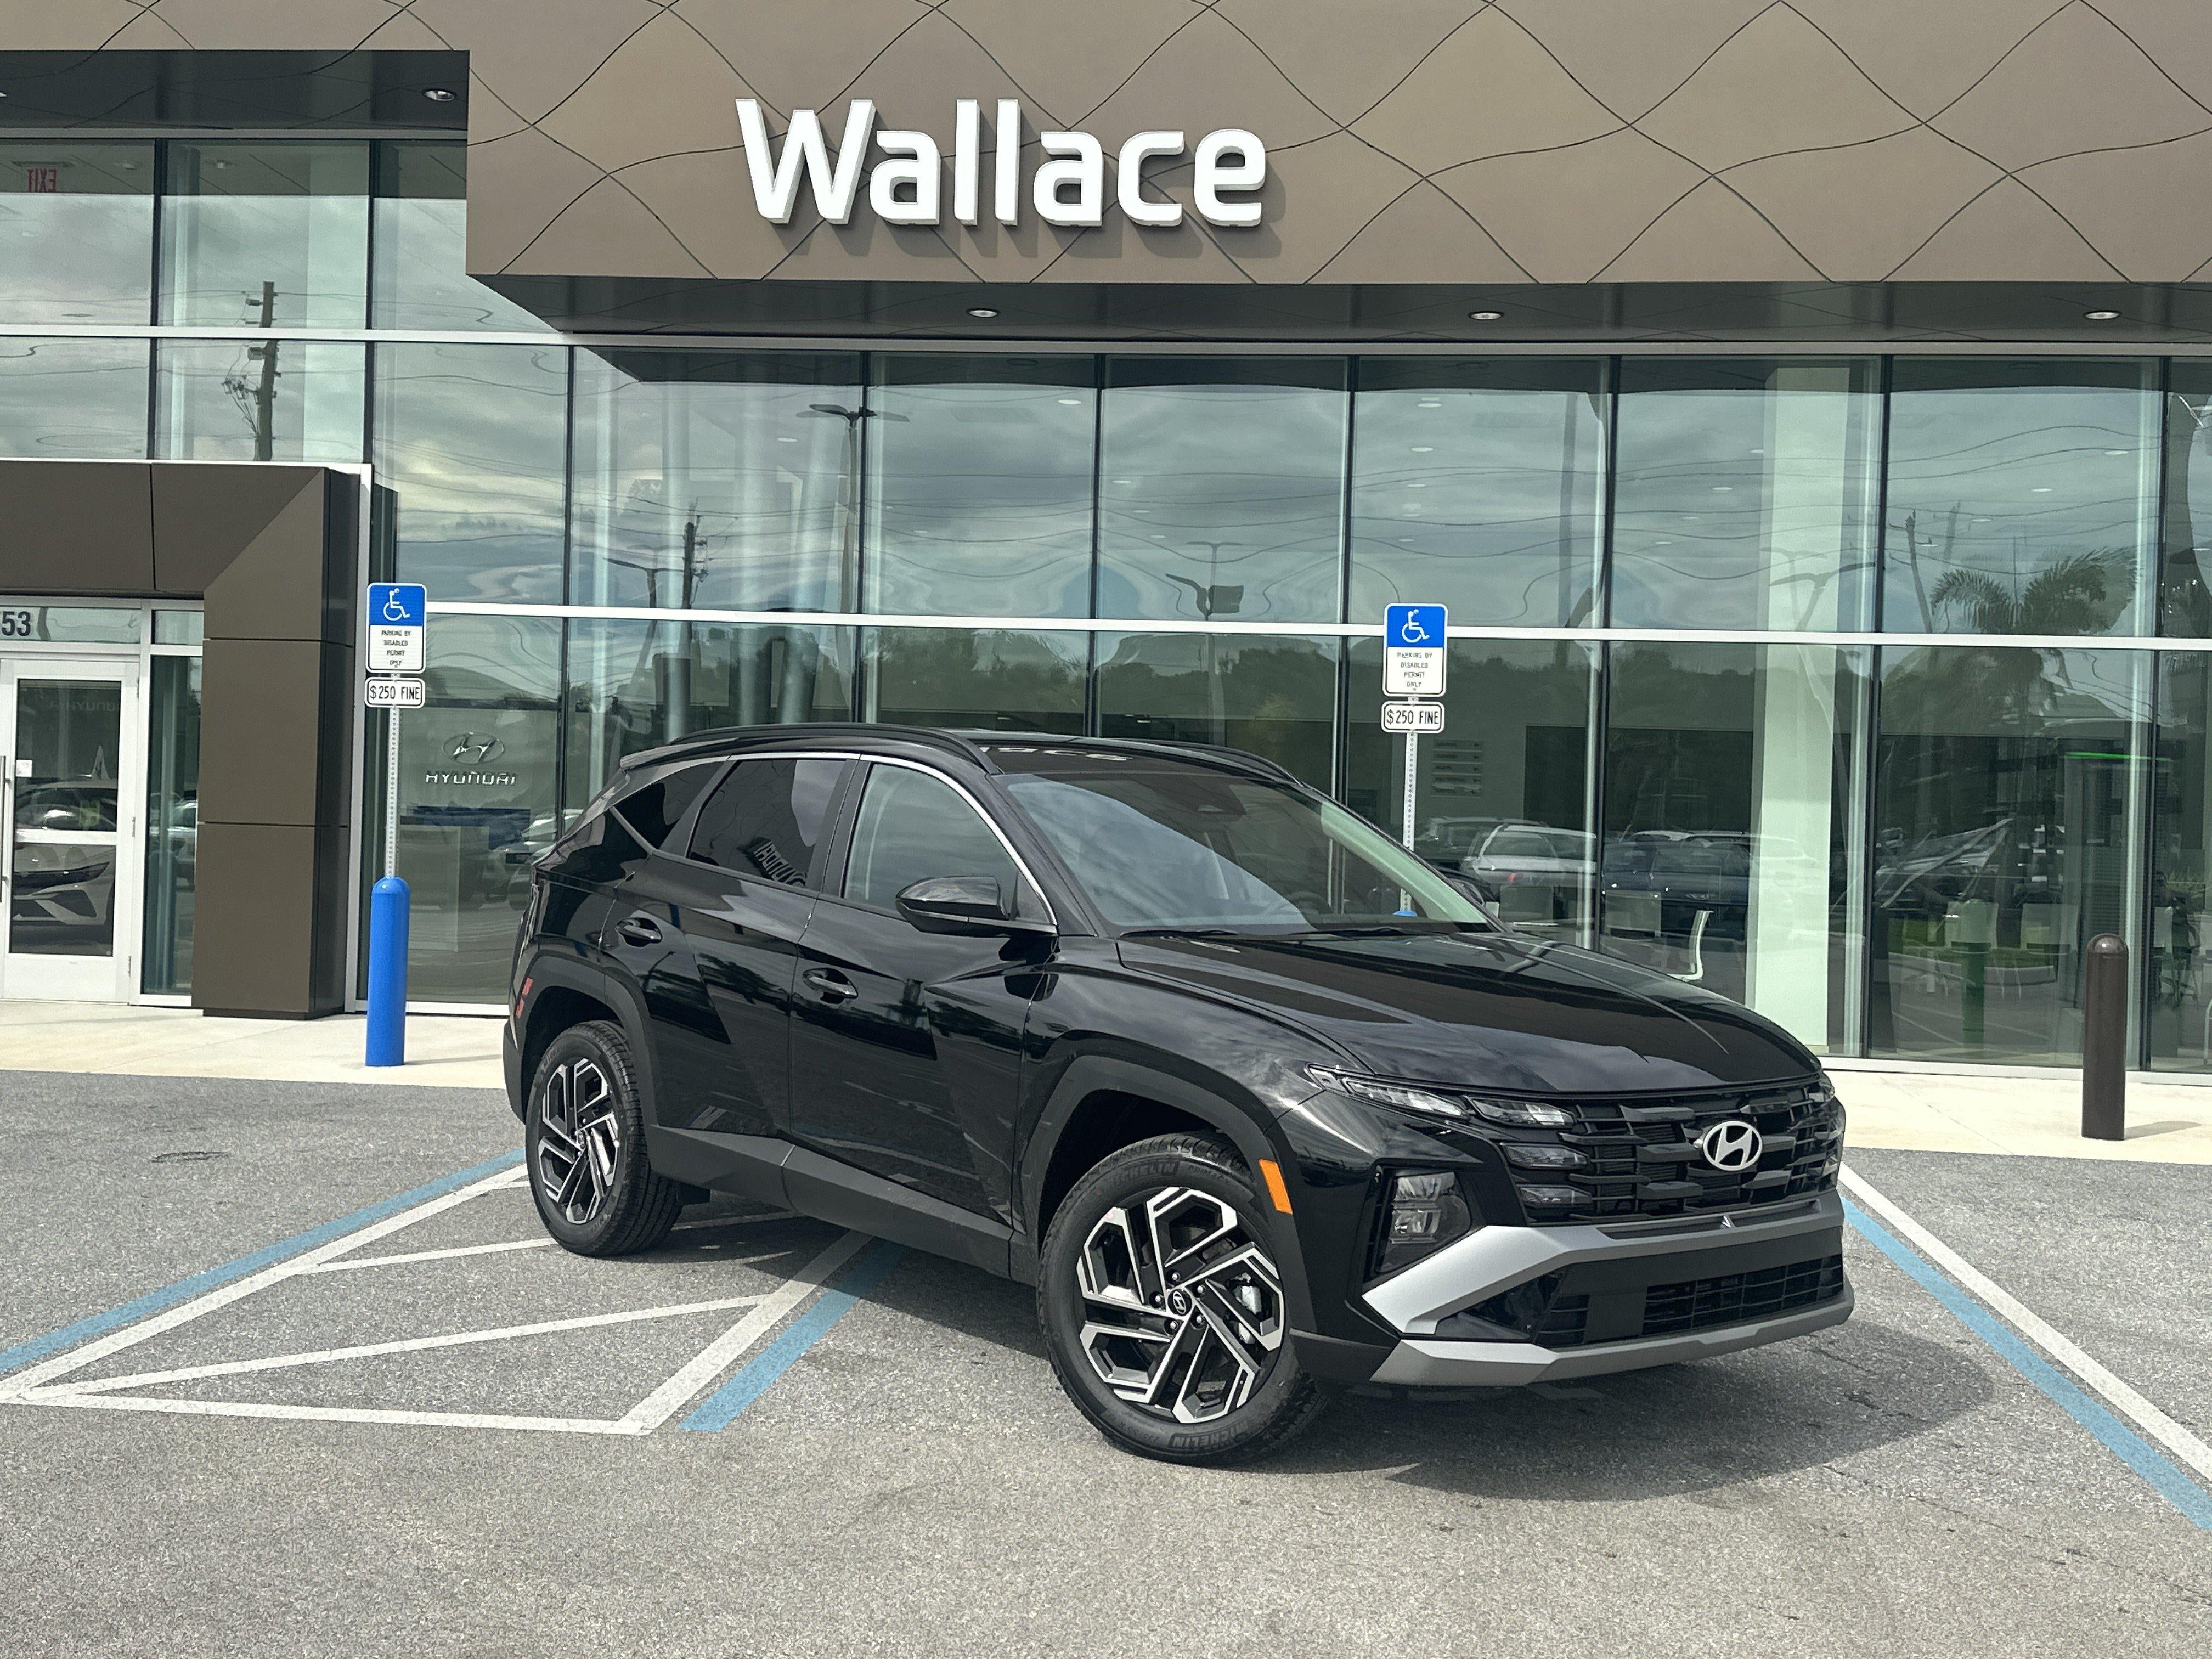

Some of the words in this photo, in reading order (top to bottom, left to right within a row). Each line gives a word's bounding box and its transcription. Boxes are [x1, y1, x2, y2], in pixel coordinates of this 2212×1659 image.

[735, 98, 1267, 228] Wallace
[2, 611, 31, 636] 53
[370, 685, 396, 701] $250
[401, 686, 420, 700] FINE
[1386, 709, 1414, 725] $250
[1419, 710, 1440, 725] FINE
[425, 770, 517, 786] HYUNDAI
